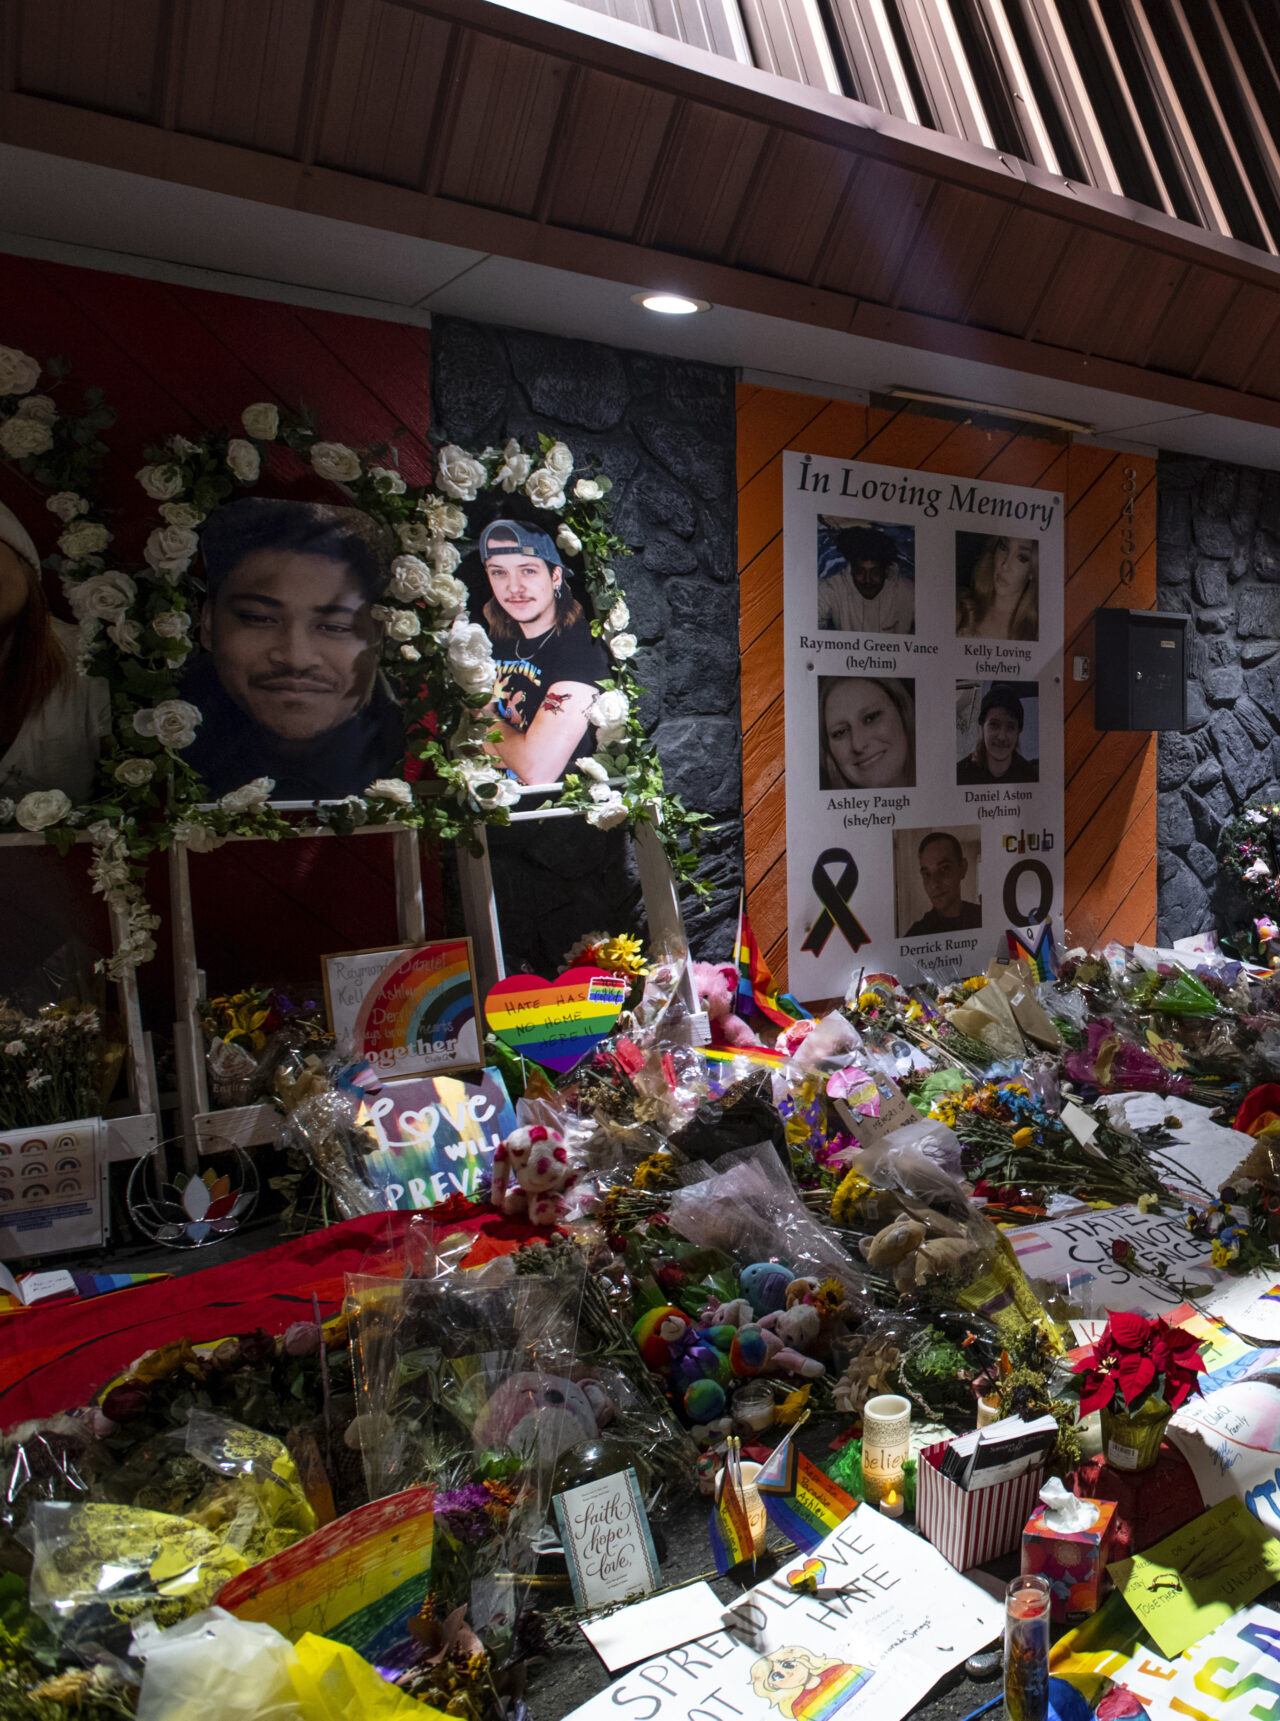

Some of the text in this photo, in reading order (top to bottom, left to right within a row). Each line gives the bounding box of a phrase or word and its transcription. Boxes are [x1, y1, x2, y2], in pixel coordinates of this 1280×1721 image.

[797, 461, 1055, 532] In Loving Memory
[799, 636, 939, 655] Raymond Green Vance
[963, 644, 1032, 661] Kelly Loving
[845, 656, 897, 671] (he/him)
[975, 660, 1021, 675] (she/her)
[826, 795, 911, 812] Ashley Paugh
[964, 789, 1033, 803] Daniel Aston
[843, 813, 896, 829] (she/her)
[977, 805, 1021, 820] (he/him)
[1005, 828, 1055, 853] club
[1003, 859, 1054, 928] Q
[899, 937, 979, 957] Derrick Rump
[504, 993, 586, 1016] HATE HAS
[515, 1011, 582, 1037] NO HOME
[364, 1037, 458, 1070] ogether
[385, 1166, 484, 1211] PREVA
[1051, 1210, 1149, 1242] HATE
[1097, 1238, 1214, 1285] SENCE
[864, 1449, 908, 1471] Believ
[798, 1491, 826, 1519] Ashley
[806, 1563, 902, 1631] HATE
[1136, 1587, 1183, 1618] TOGETHER
[611, 1604, 768, 1720] SPREAD
